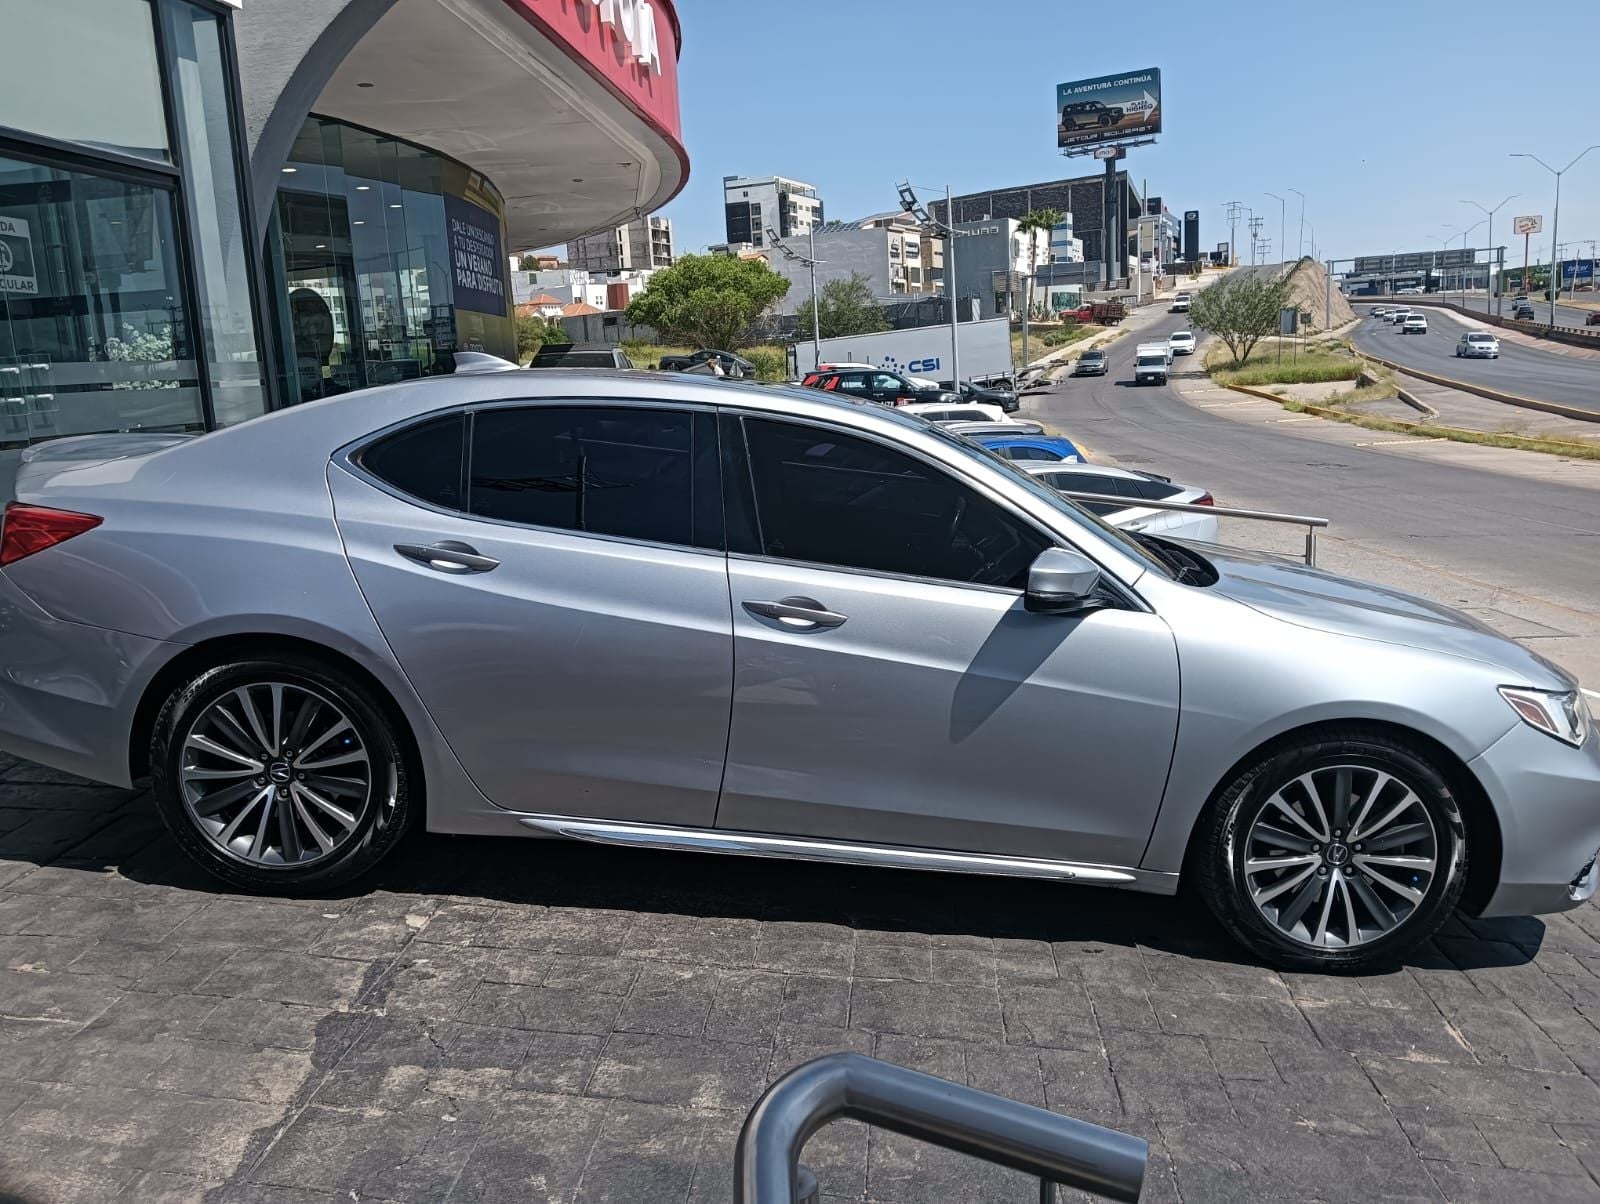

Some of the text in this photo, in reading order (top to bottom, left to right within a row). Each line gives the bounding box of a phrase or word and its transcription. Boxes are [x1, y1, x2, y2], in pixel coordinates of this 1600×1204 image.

[1063, 75, 1152, 96] LA AVENTURA CONTINÚA
[452, 218, 466, 234] DALE
[466, 224, 474, 237] UN
[454, 234, 458, 248] A
[458, 236, 466, 250] TU
[455, 249, 493, 276] UN VERANO
[456, 268, 478, 290] PARA
[908, 357, 940, 373] CSI
